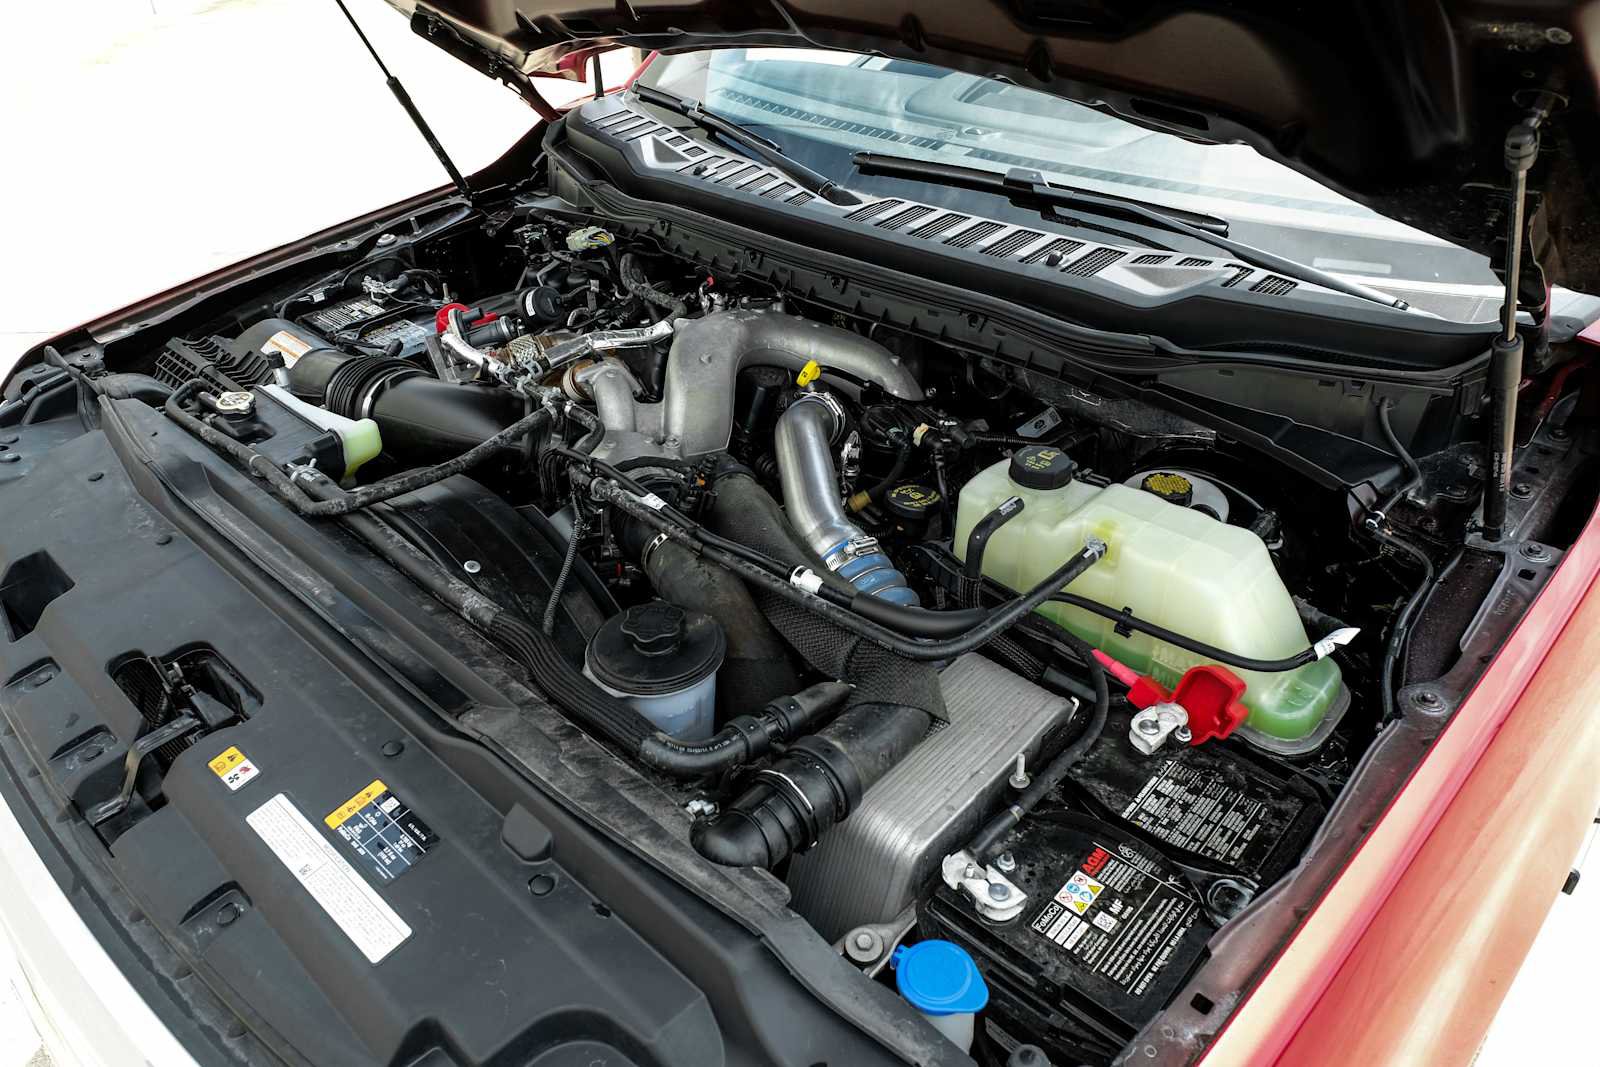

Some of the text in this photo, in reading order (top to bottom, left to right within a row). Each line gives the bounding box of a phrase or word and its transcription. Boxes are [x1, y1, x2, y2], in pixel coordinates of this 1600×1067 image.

[1082, 848, 1107, 872] AGM
[1035, 905, 1060, 930] FoMoCo
[1109, 899, 1123, 914] MF
